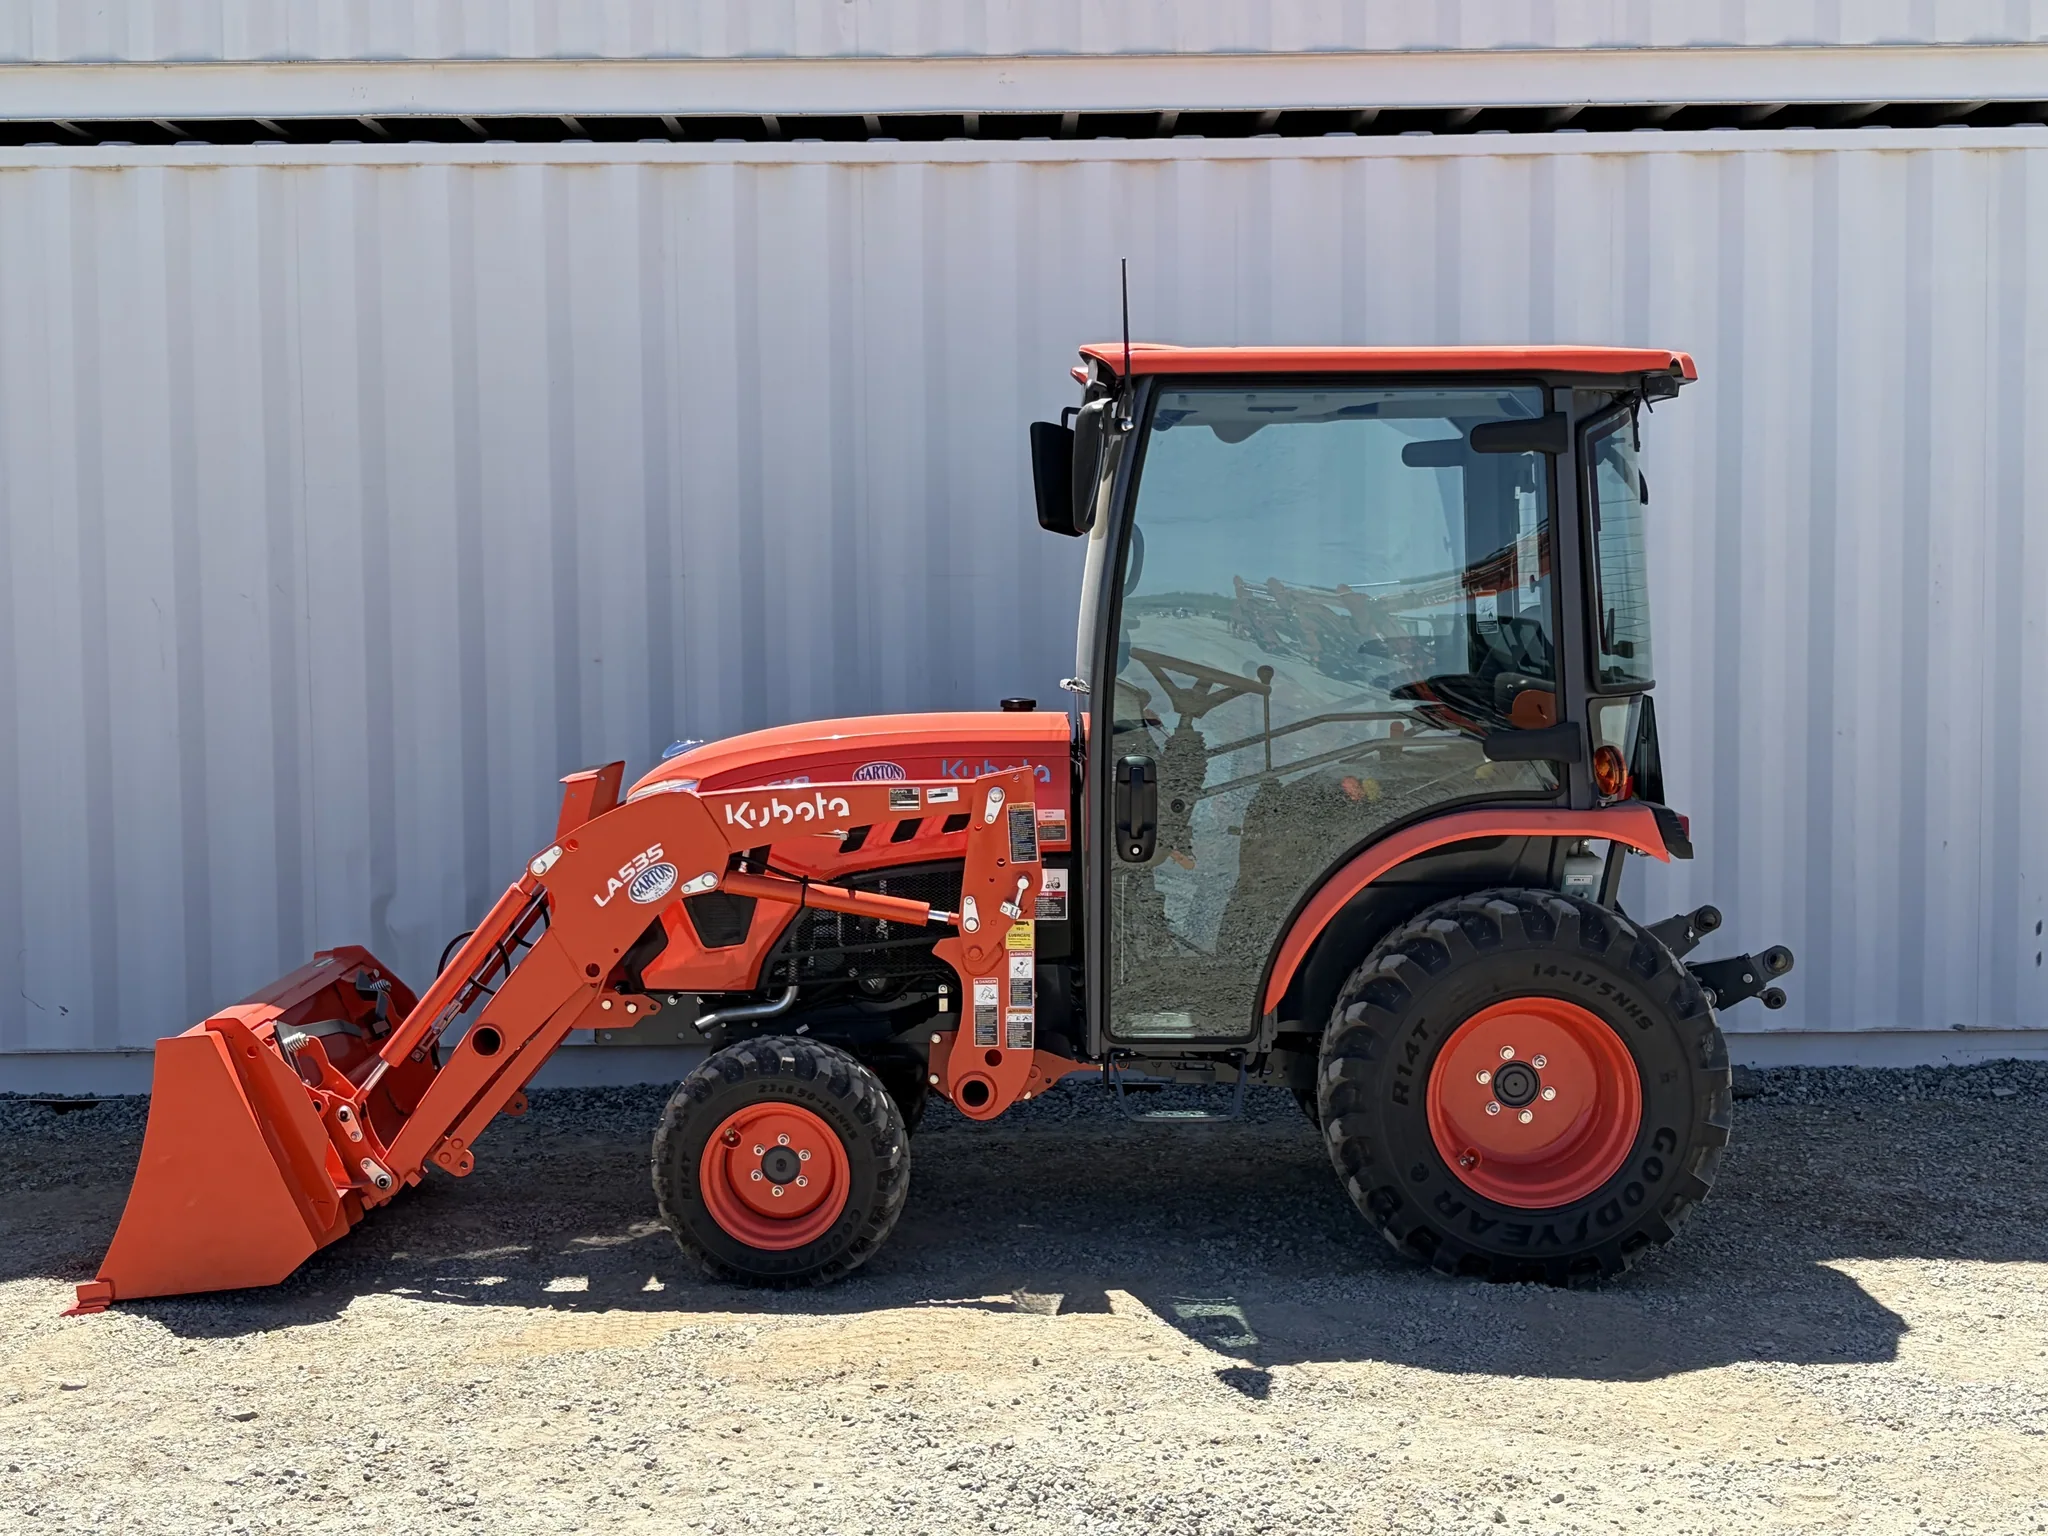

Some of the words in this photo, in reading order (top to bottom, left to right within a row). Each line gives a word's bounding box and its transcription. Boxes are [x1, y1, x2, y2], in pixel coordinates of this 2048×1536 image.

[855, 764, 901, 780] GARTON
[942, 759, 1051, 782] Kuba
[725, 792, 850, 829] Kubota
[593, 842, 664, 907] LA535
[631, 864, 673, 897] GARTON
[1392, 1017, 1430, 1106] R14T
[1434, 1125, 1678, 1247] GOODYEAR
